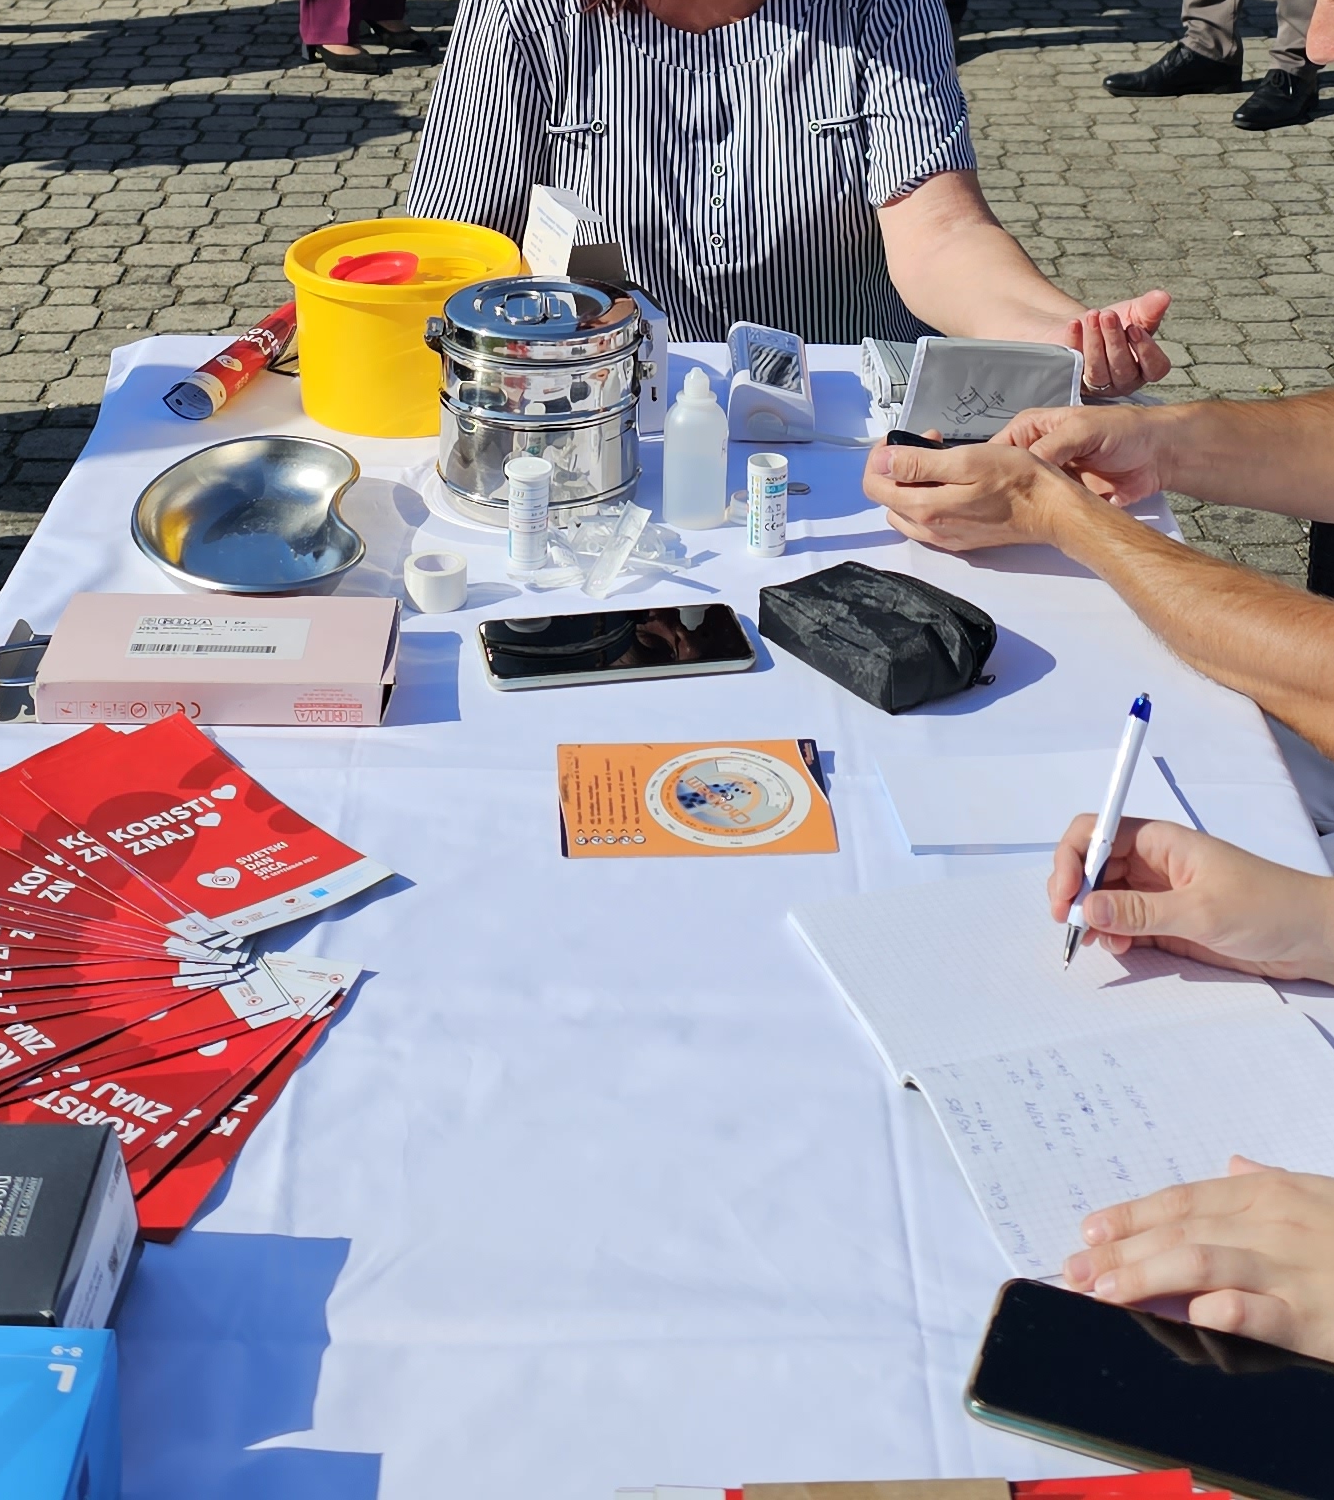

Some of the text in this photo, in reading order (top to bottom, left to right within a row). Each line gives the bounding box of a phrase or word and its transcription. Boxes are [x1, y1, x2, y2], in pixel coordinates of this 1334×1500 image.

[157, 617, 213, 627] GIMA
[294, 709, 348, 723] GIMA
[107, 796, 216, 843] KORISTI
[124, 824, 195, 856] ZNAJ
[235, 841, 289, 865] SVJETSKI
[244, 856, 275, 871] DAN
[253, 861, 288, 877] SRCA
[90, 1082, 173, 1124] ZNAJ
[51, 1345, 83, 1358] 8-9
[48, 1364, 76, 1392] L
